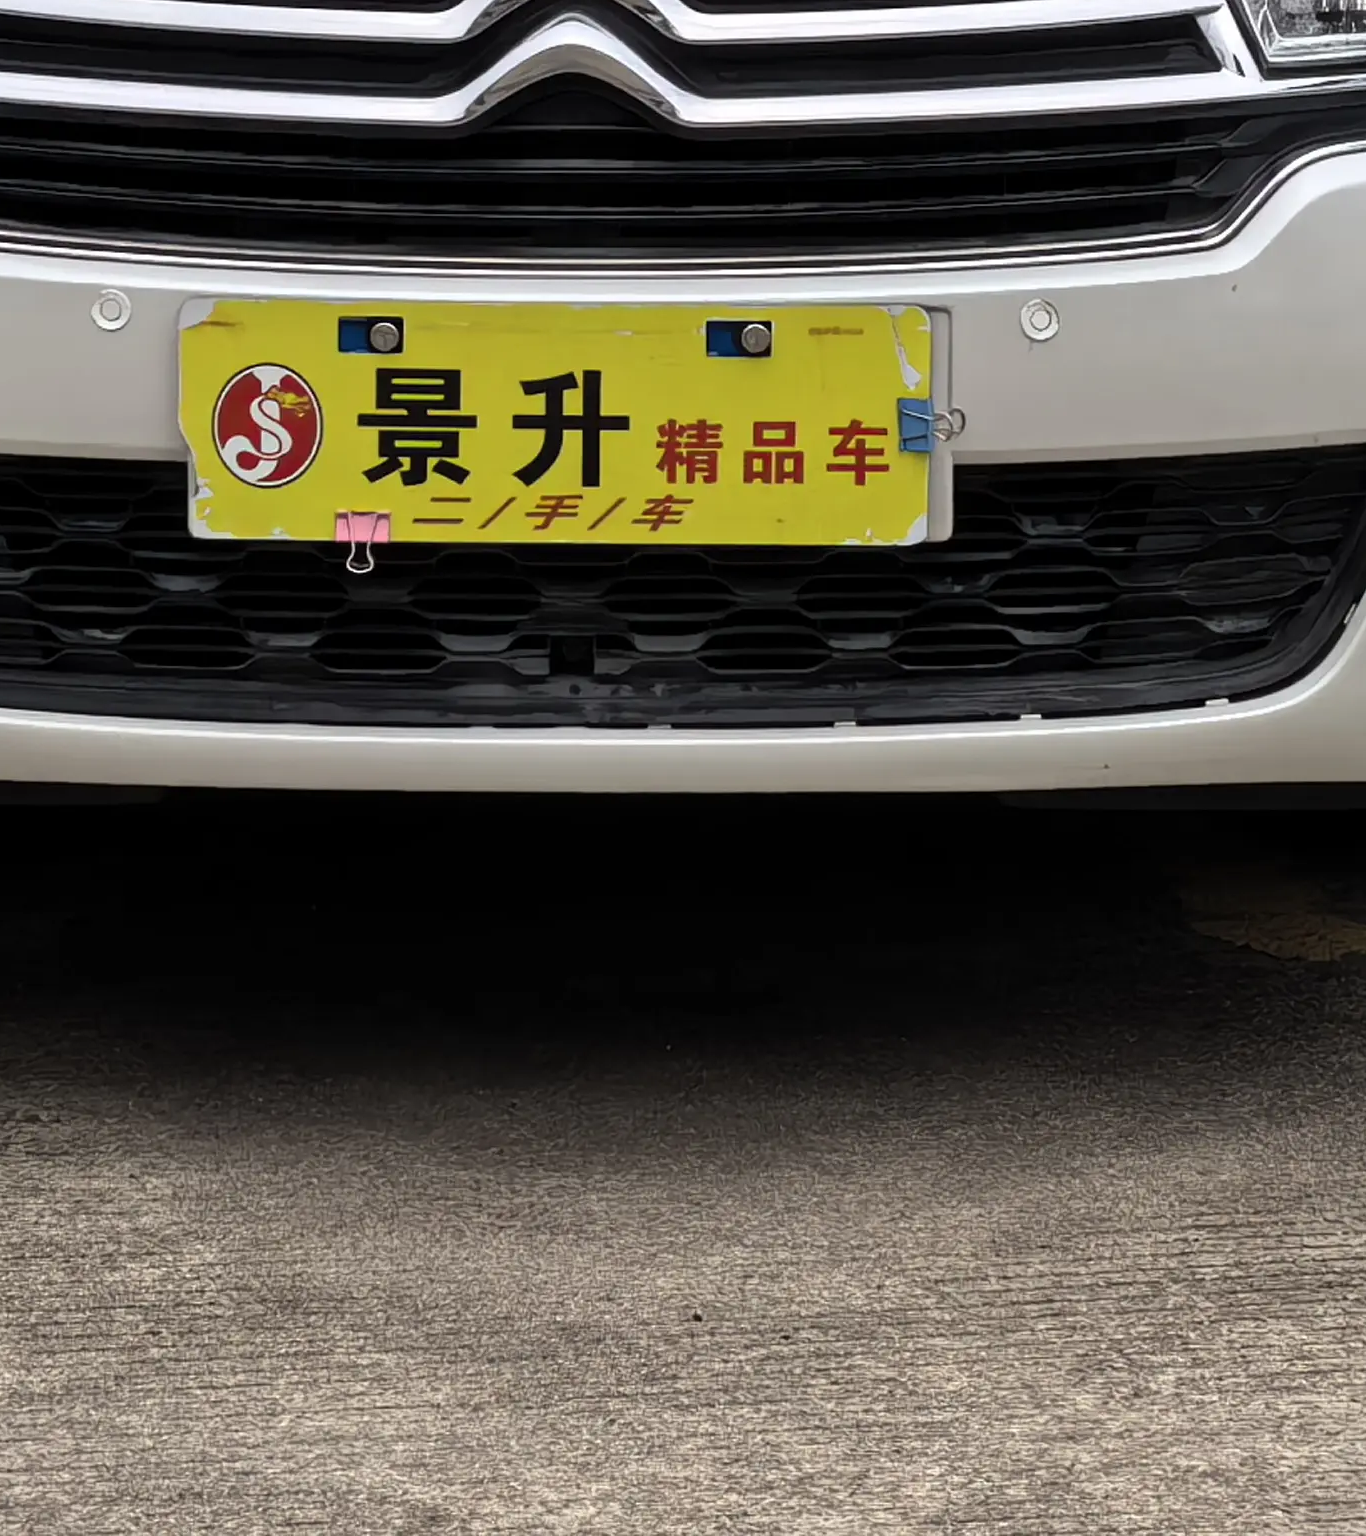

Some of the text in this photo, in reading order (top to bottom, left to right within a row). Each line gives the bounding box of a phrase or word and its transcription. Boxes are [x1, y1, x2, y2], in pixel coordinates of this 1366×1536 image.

[357, 368, 890, 488] 景升 精品车
